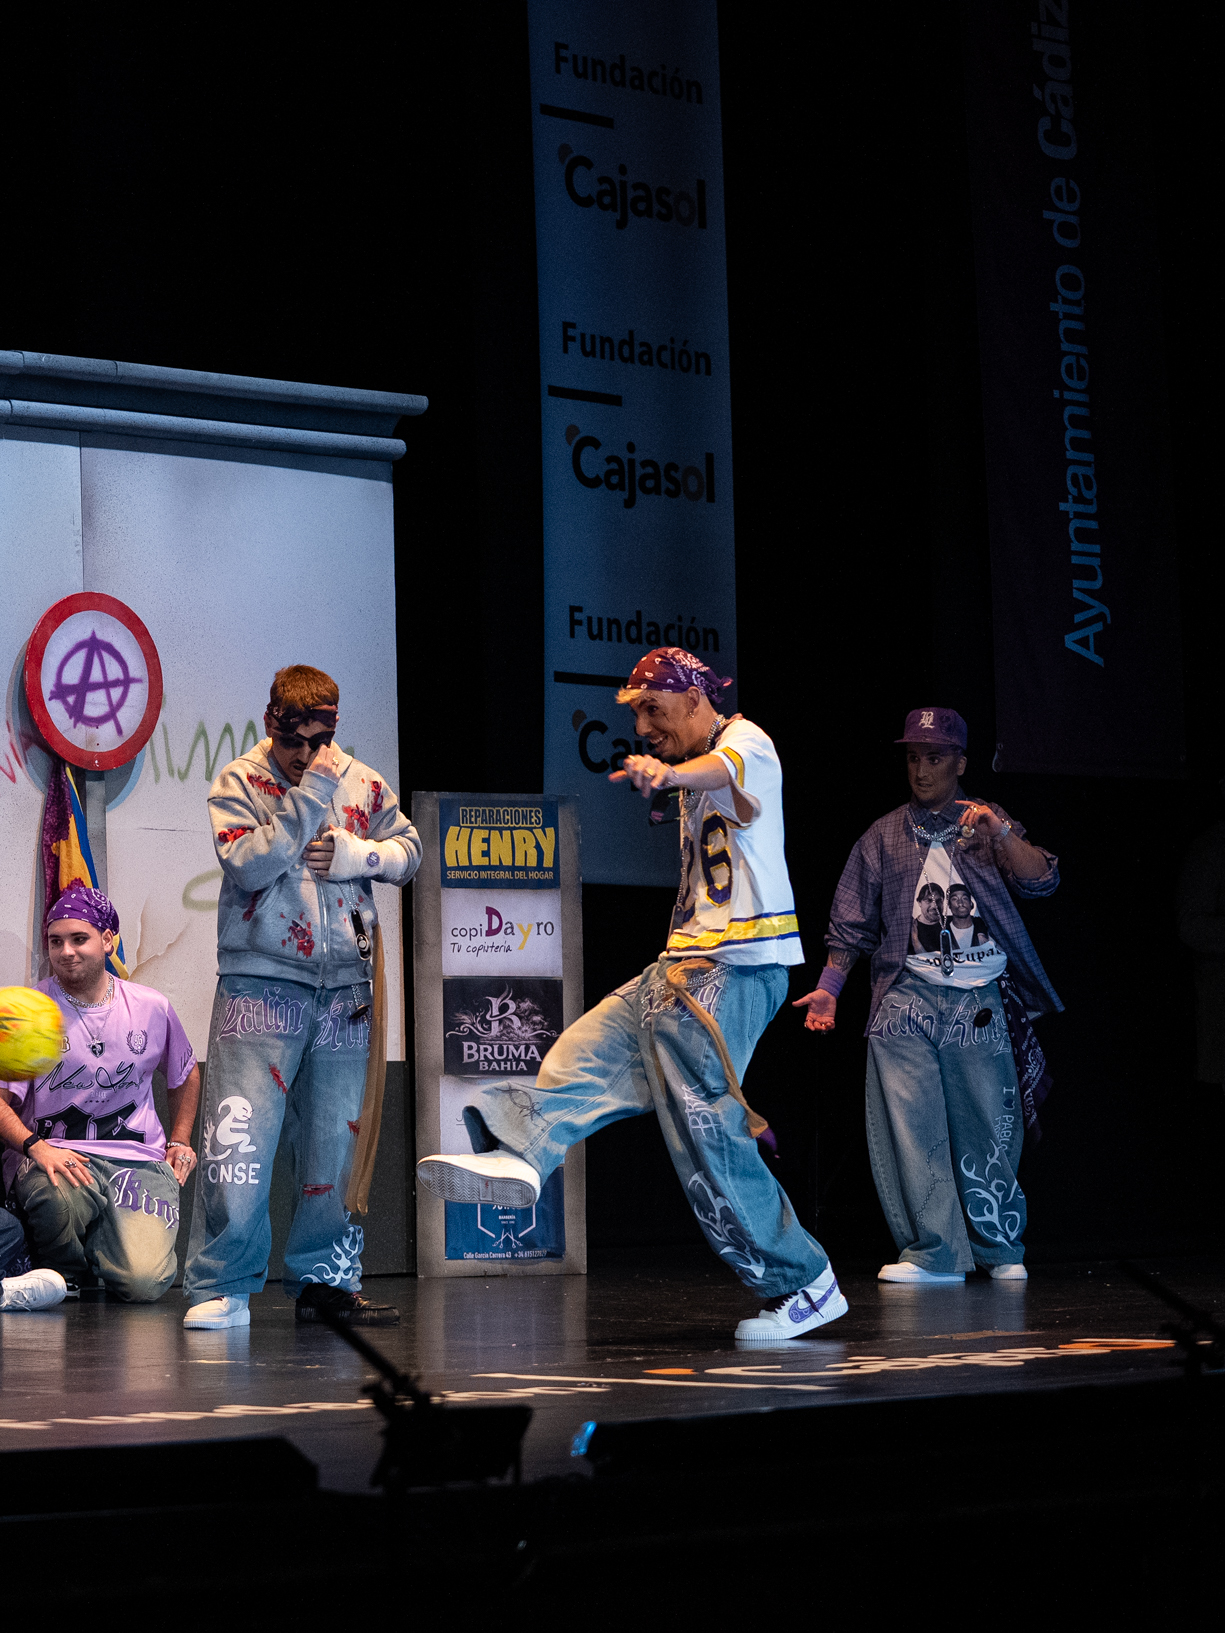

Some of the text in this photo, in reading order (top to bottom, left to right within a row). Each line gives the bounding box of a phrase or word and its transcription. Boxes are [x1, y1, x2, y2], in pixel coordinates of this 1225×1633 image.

[554, 41, 704, 104] Fundación
[563, 153, 708, 230] Cajasol
[562, 321, 713, 377] Fundación
[1030, 0, 1111, 668] Ayuntamiento de Cádiz
[570, 434, 716, 509] Cajasol
[569, 604, 720, 652] Fundación
[459, 807, 543, 827] REPARACIONES
[444, 826, 556, 868] HENRY
[446, 870, 554, 880] SERVICIO INTEGRAL DEL HOGAR
[461, 1041, 543, 1064] BRUMA
[478, 1058, 528, 1071] BAHÍA
